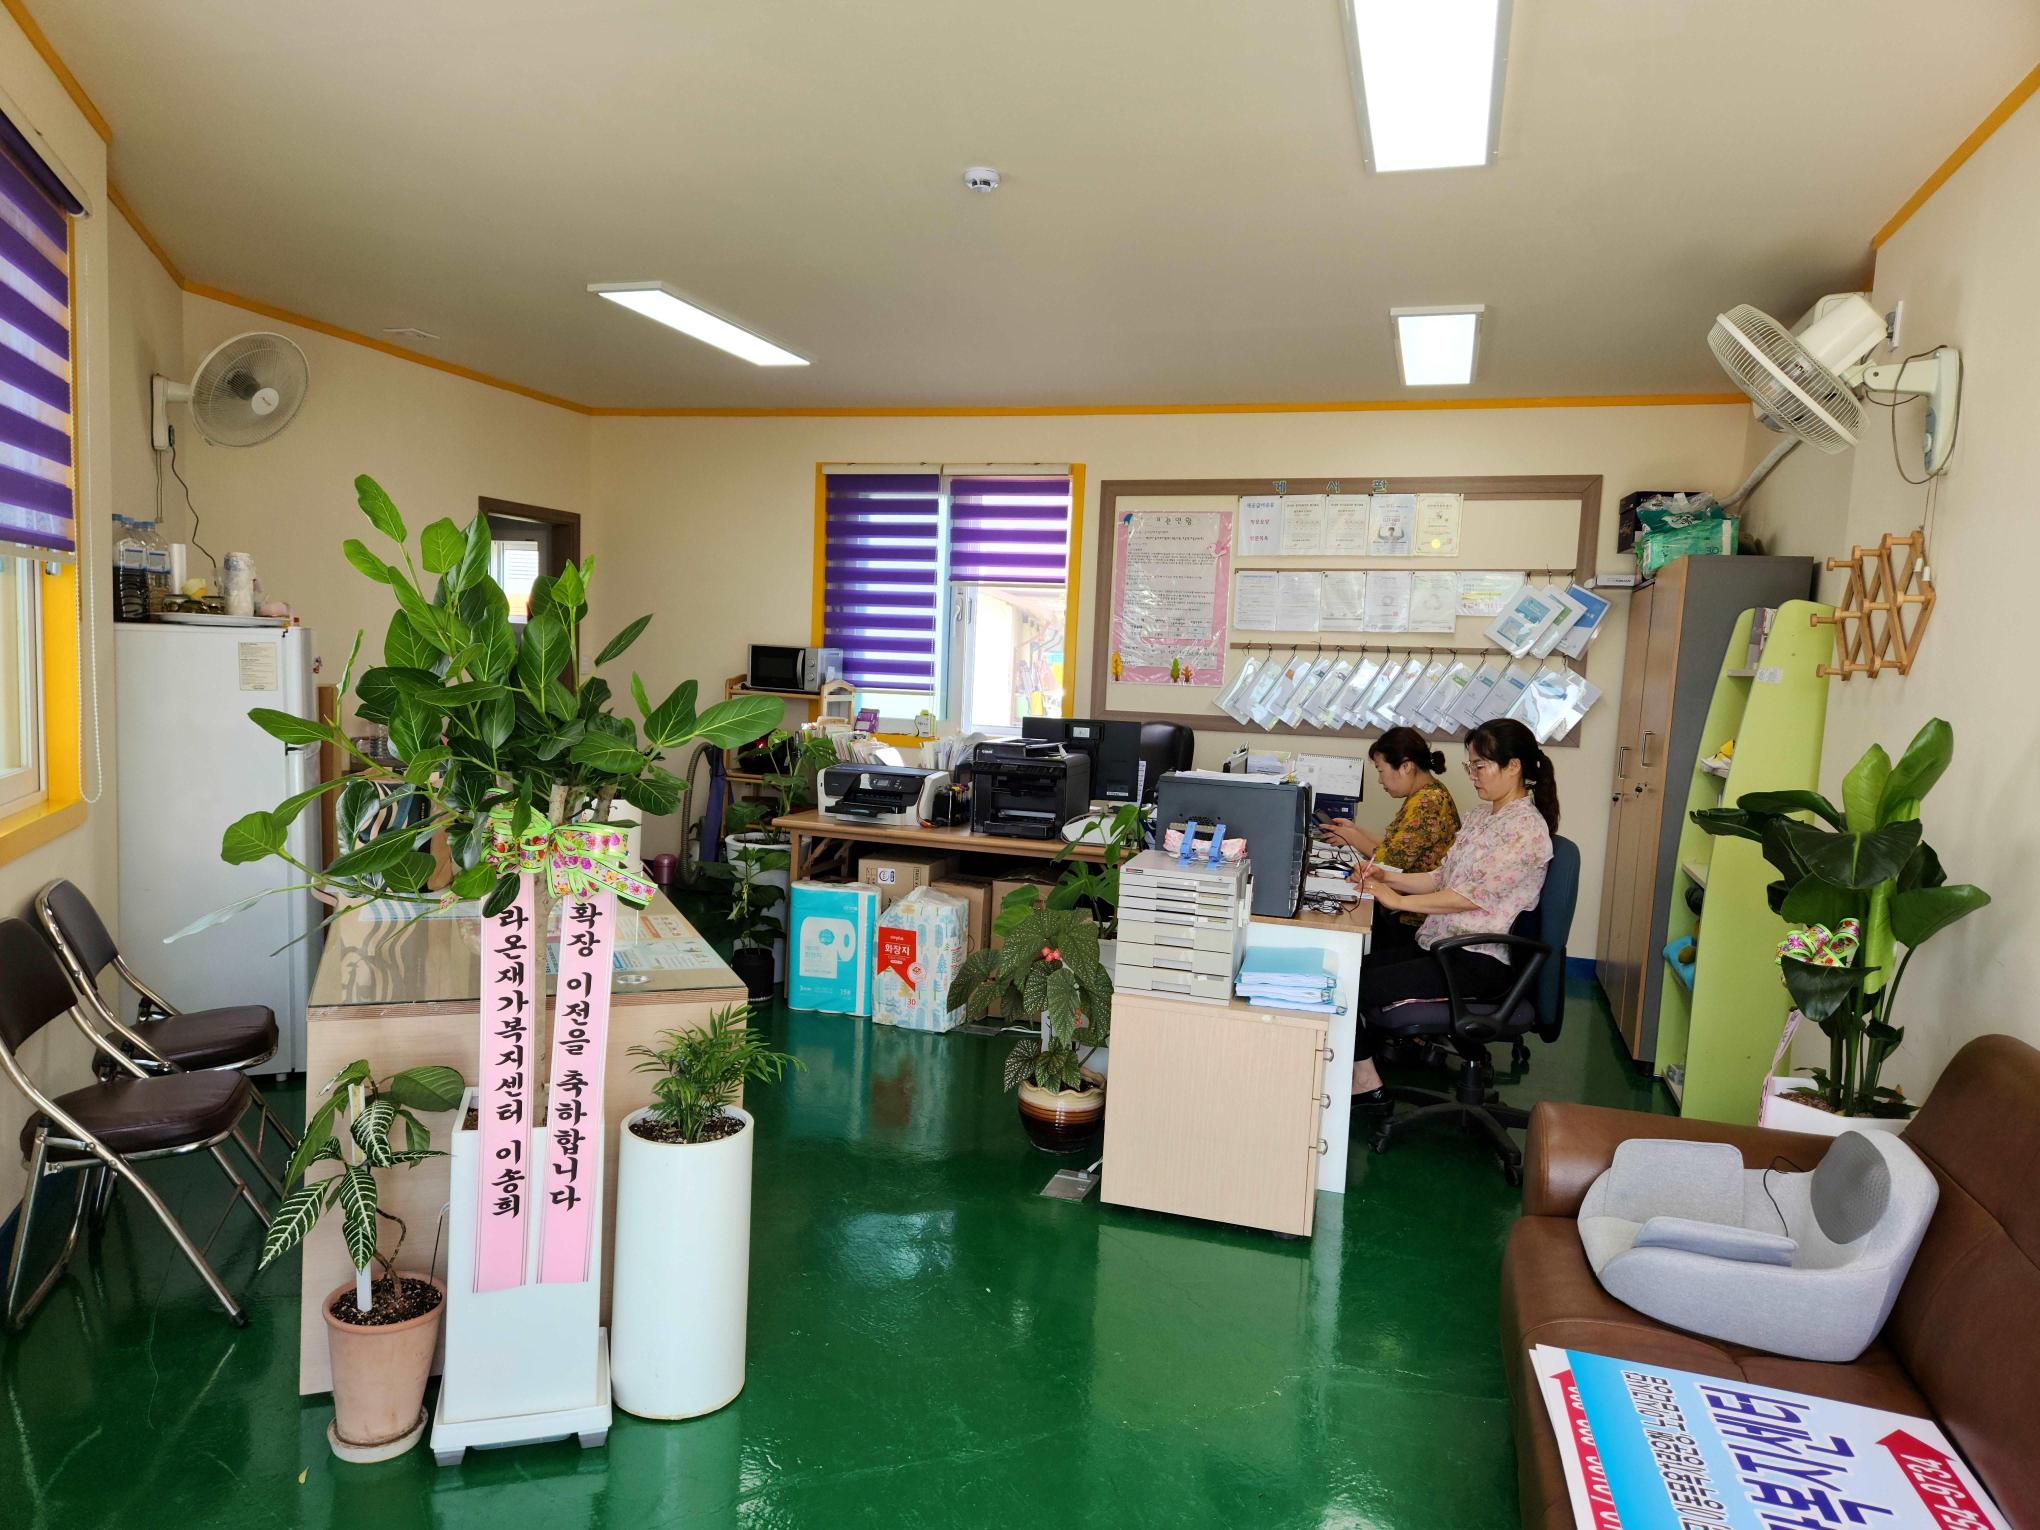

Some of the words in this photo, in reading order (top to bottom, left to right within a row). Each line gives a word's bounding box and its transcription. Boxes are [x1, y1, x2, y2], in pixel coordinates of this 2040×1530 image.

[566, 902, 603, 958] 확장
[884, 943, 910, 956] 화장지
[493, 905, 530, 1125] 라온재가복지센터
[558, 971, 593, 1056] 이전을
[491, 1139, 526, 1219] 이송희
[548, 1069, 589, 1212] 축하합니다
[1900, 1453, 1989, 1530] 54-9734
